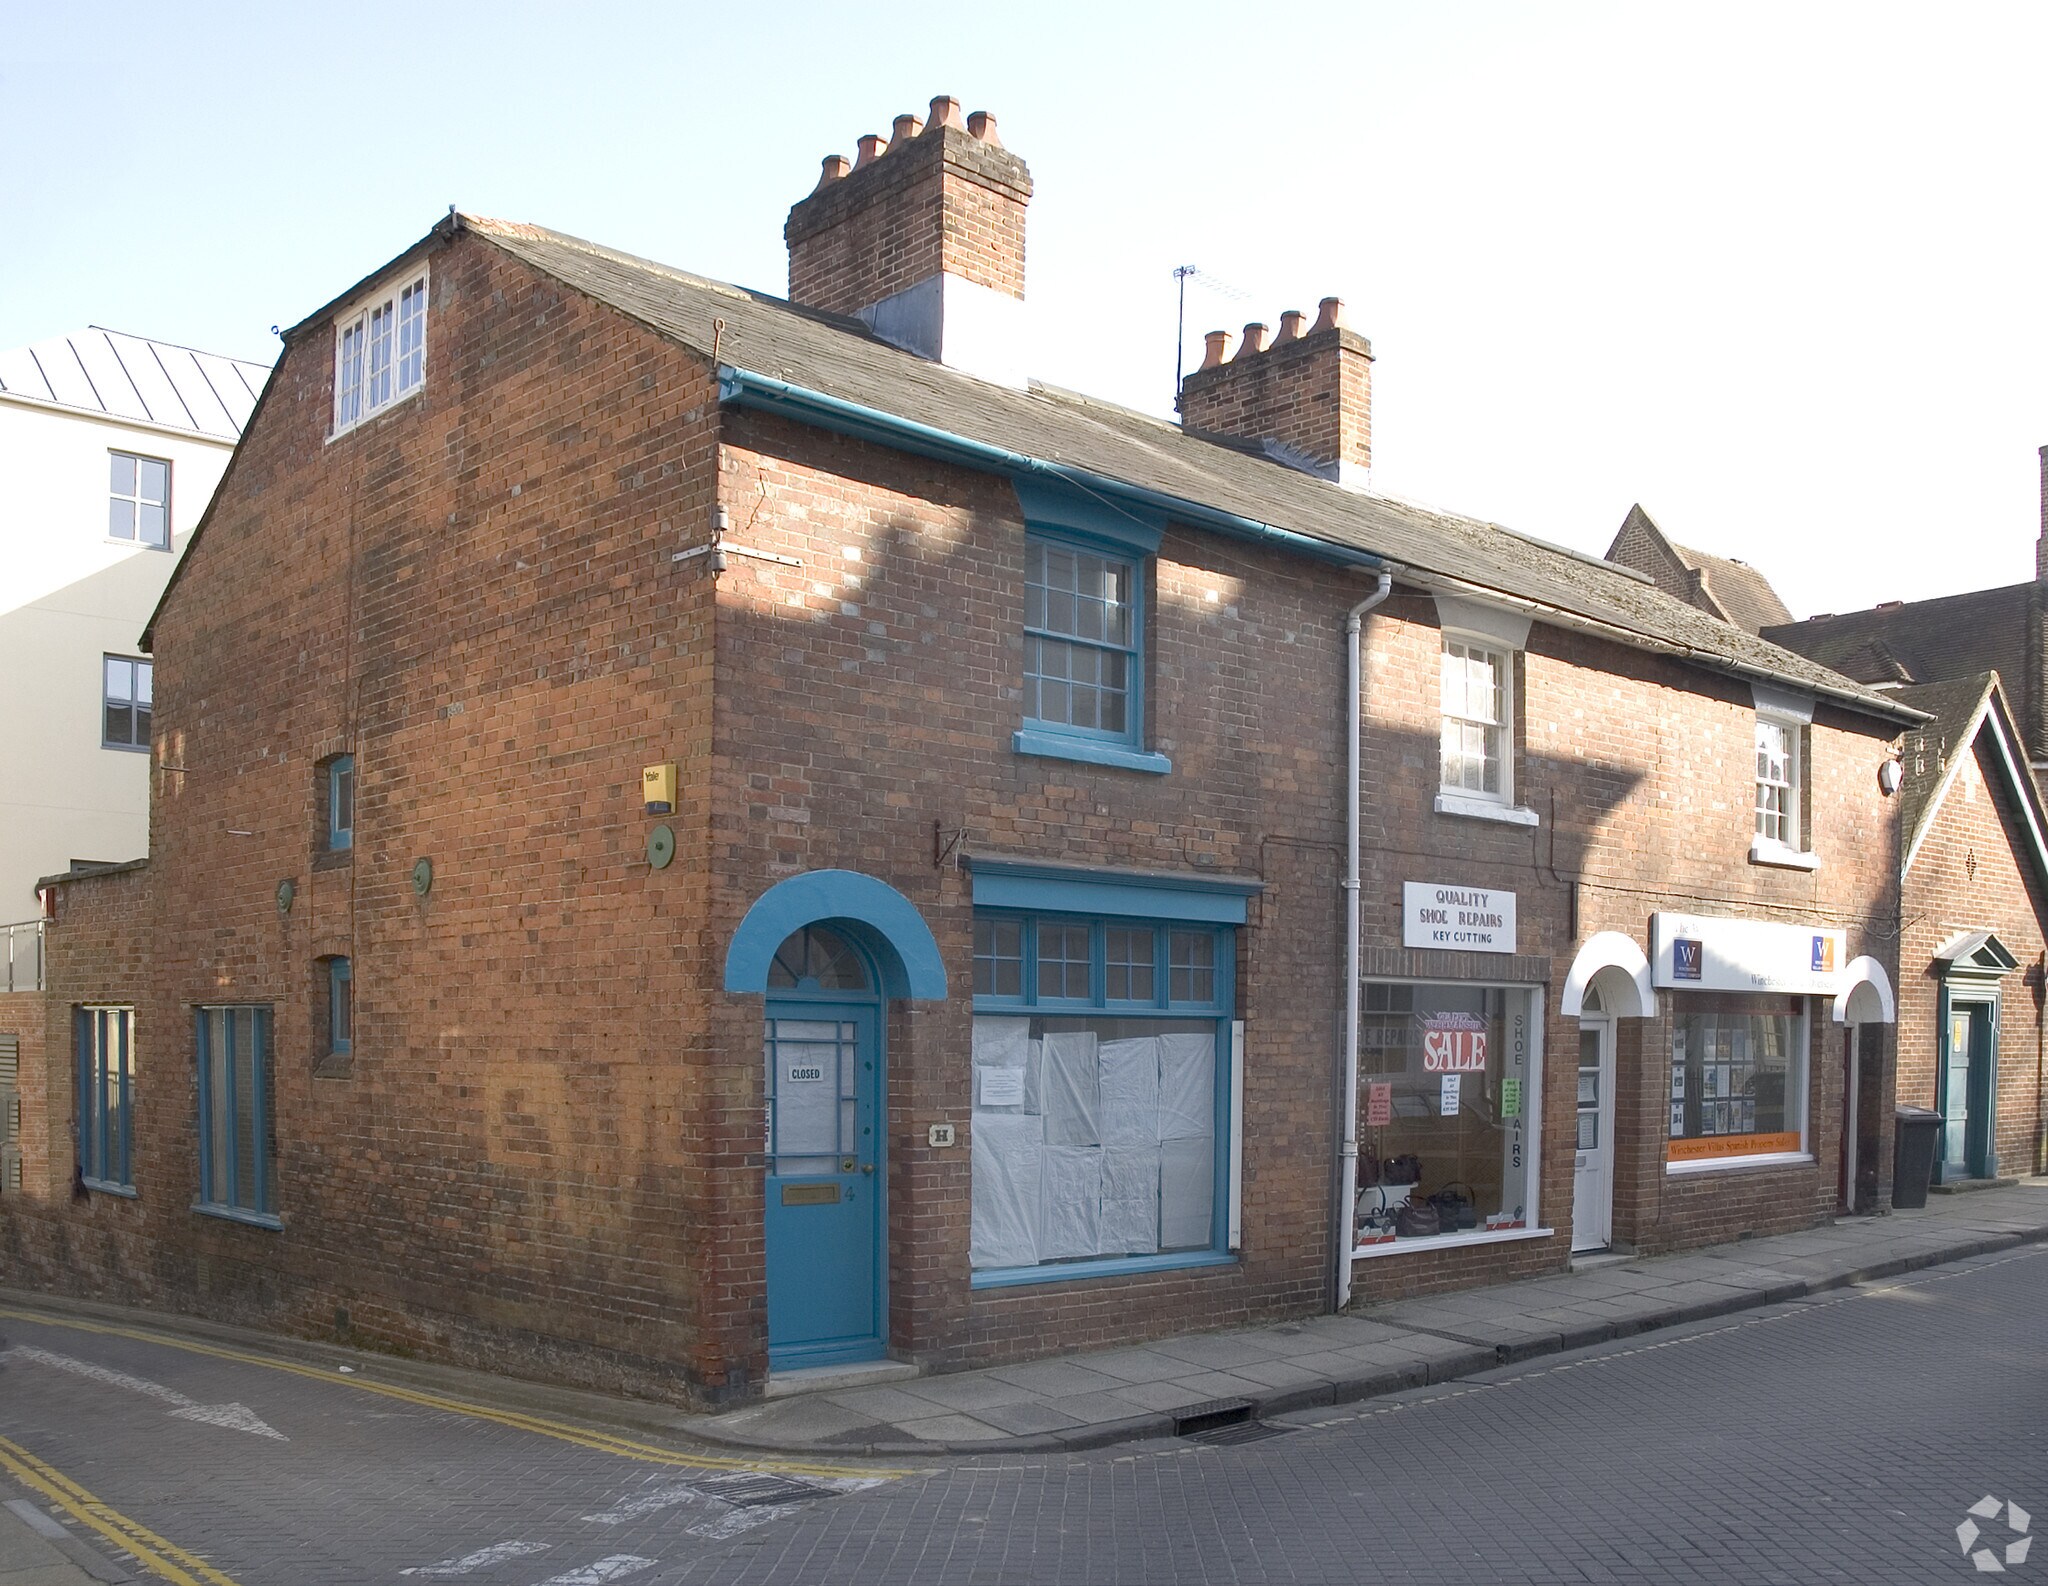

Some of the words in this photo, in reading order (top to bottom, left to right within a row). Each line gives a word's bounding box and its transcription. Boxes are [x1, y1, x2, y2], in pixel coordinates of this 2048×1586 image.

[645, 771, 659, 782] Yale
[1435, 889, 1489, 908] QUALITY
[1419, 908, 1449, 925] SHOE
[1458, 911, 1503, 928] REPAIRS
[1433, 930, 1451, 942] KEY
[1453, 932, 1492, 944] CUTTING
[1680, 945, 1697, 963] W
[1816, 941, 1830, 957] W
[1376, 1028, 1420, 1046] REPAIRS
[1514, 1014, 1523, 1066] SHOE
[1424, 1031, 1486, 1071] SALE
[791, 1068, 820, 1080] CLOSED
[934, 1129, 949, 1142] H
[1670, 1143, 1706, 1156] Winchester
[1707, 1141, 1725, 1153] Villas
[1726, 1140, 1749, 1153] Spanish
[844, 1185, 856, 1202] 4
